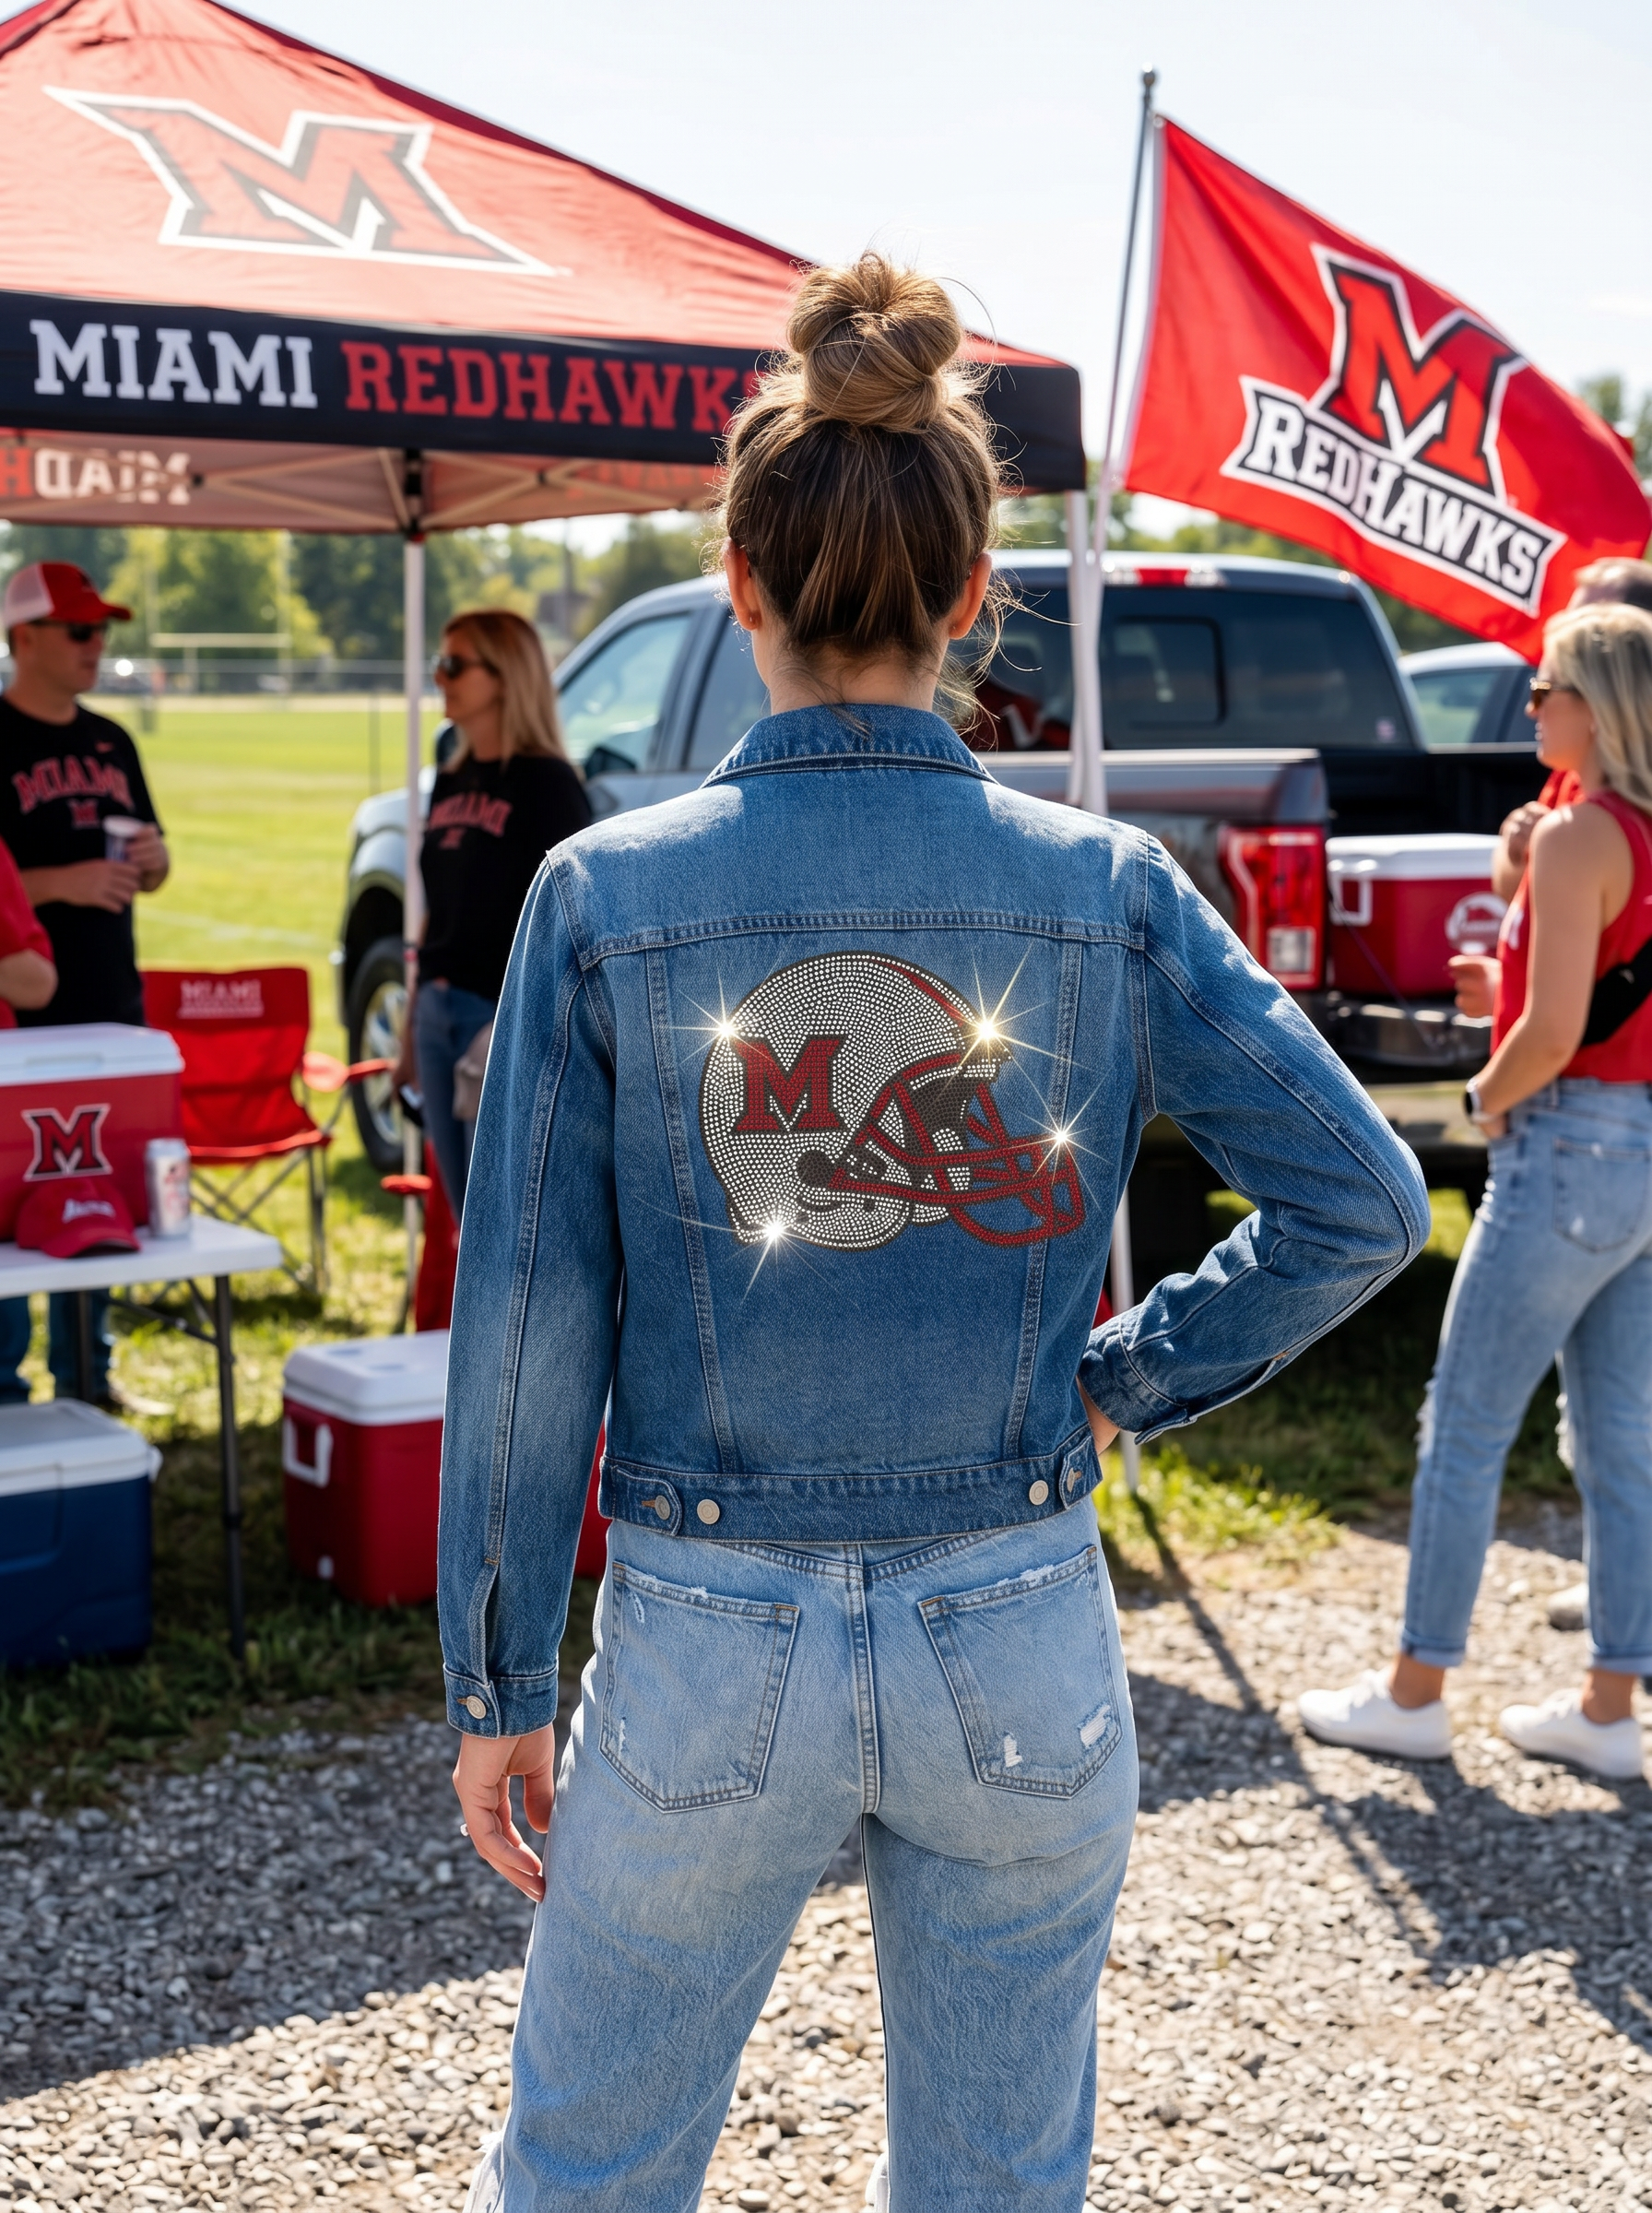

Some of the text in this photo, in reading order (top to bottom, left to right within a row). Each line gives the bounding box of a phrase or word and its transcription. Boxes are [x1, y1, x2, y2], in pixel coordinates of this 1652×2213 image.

[50, 90, 551, 274] M
[30, 318, 769, 433] MIAMI REDHAWK
[1316, 253, 1523, 499] M
[1244, 395, 1545, 596] REDHAWKS
[25, 1106, 112, 1179] M
[730, 1036, 844, 1134] M
